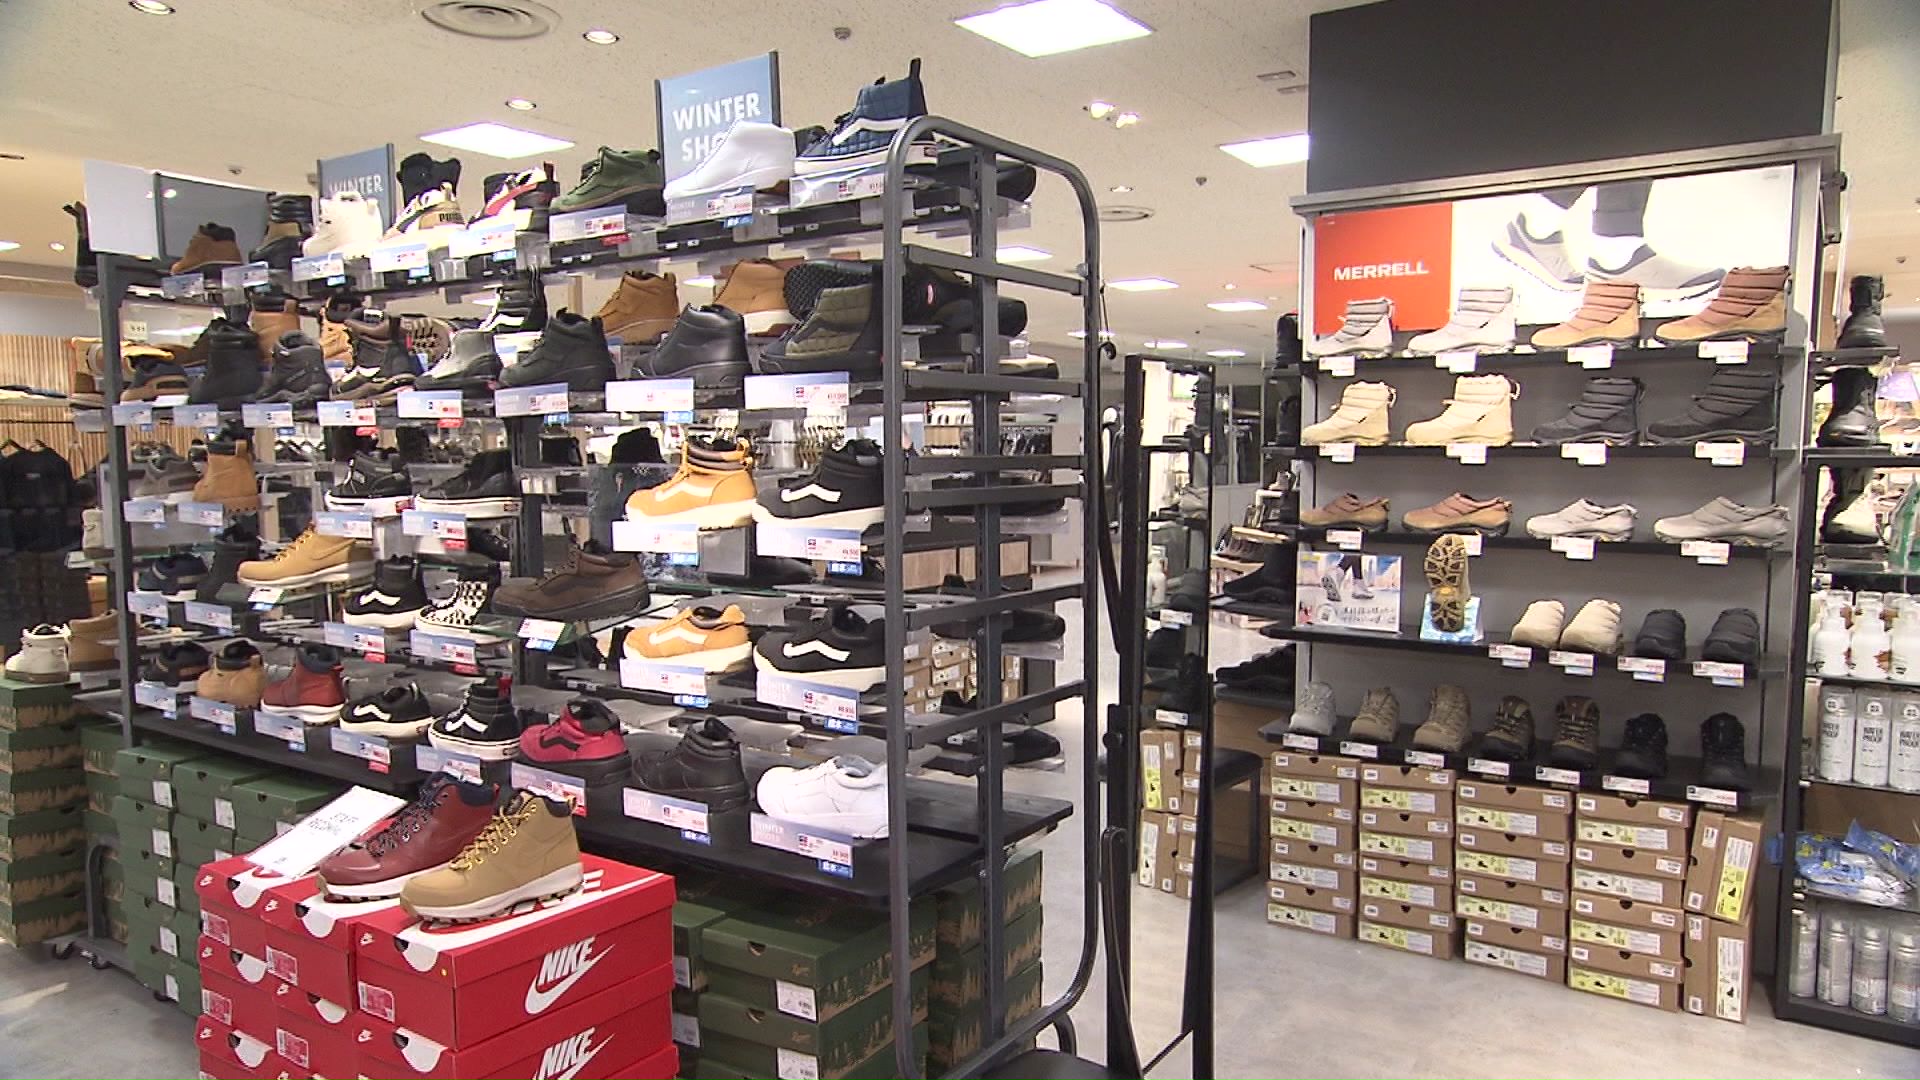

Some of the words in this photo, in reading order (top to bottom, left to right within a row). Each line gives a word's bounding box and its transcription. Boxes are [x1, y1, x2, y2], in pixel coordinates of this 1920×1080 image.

[672, 92, 761, 131] WINTER
[329, 173, 384, 194] WINTER
[1334, 260, 1429, 281] MERRELL
[537, 935, 596, 986] NIKE
[538, 1026, 596, 1080] NIKE
